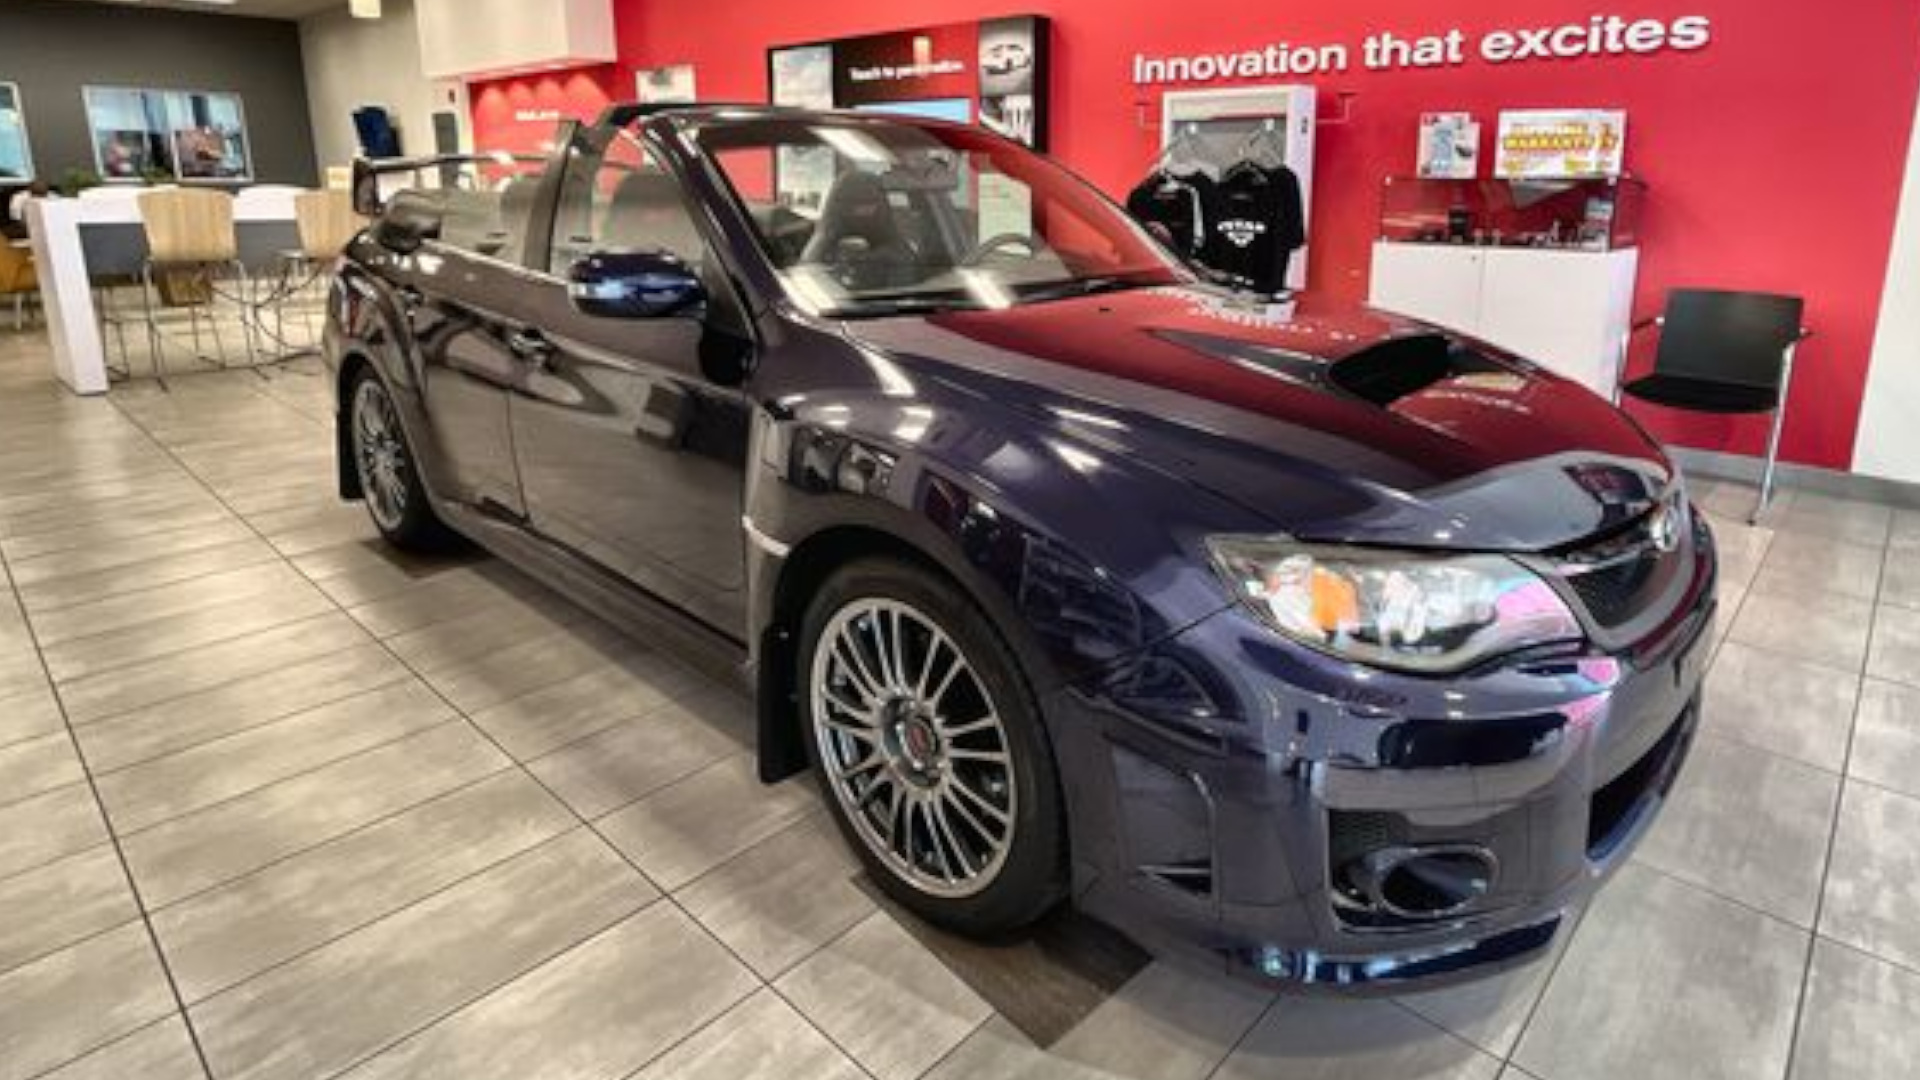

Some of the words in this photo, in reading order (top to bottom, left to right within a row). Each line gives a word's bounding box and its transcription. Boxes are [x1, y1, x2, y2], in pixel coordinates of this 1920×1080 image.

[1133, 42, 1346, 84] Innovation
[1364, 29, 1463, 68] that
[1481, 14, 1711, 60] excites
